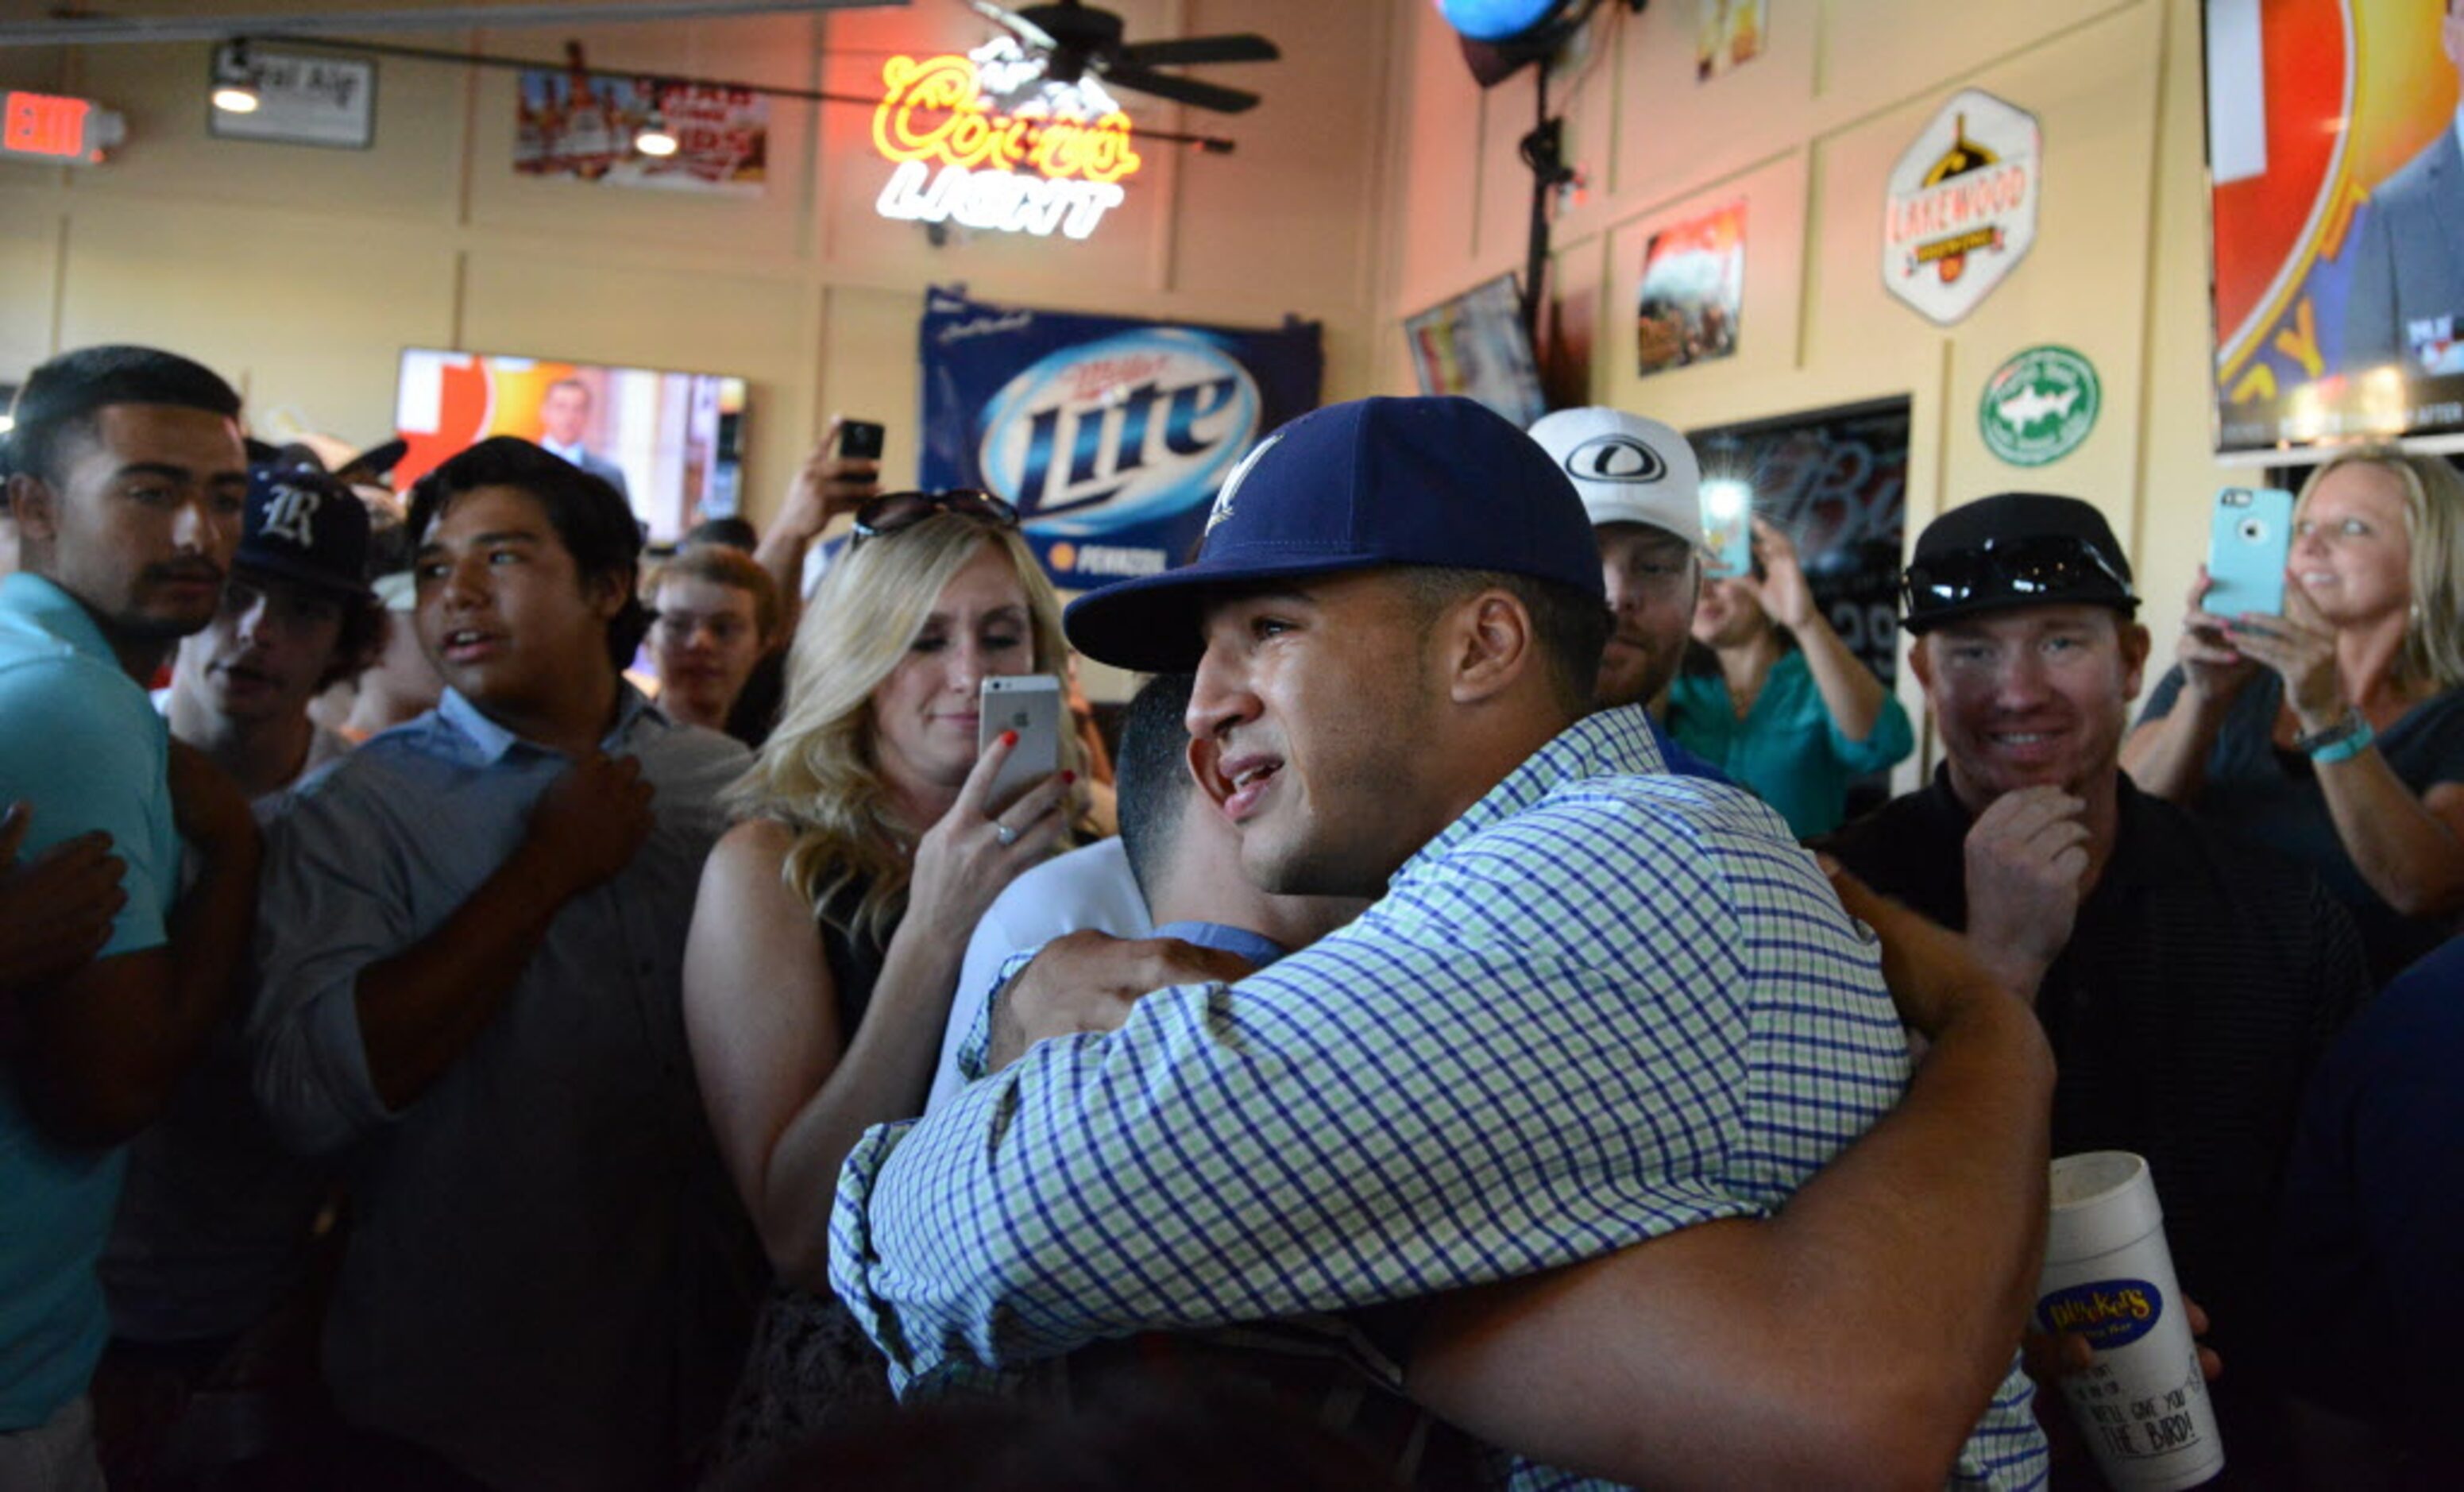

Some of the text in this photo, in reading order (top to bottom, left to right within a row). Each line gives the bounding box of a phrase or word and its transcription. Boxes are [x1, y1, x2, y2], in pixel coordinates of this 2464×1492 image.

[4, 90, 90, 157] EXIT
[1887, 165, 2027, 248] LAKEWOOD
[1015, 376, 1239, 519] Lite
[2099, 1409, 2196, 1455] THE BIRD!
[2130, 1398, 2157, 1421] GIVE
[2162, 1388, 2186, 1413] YOU
